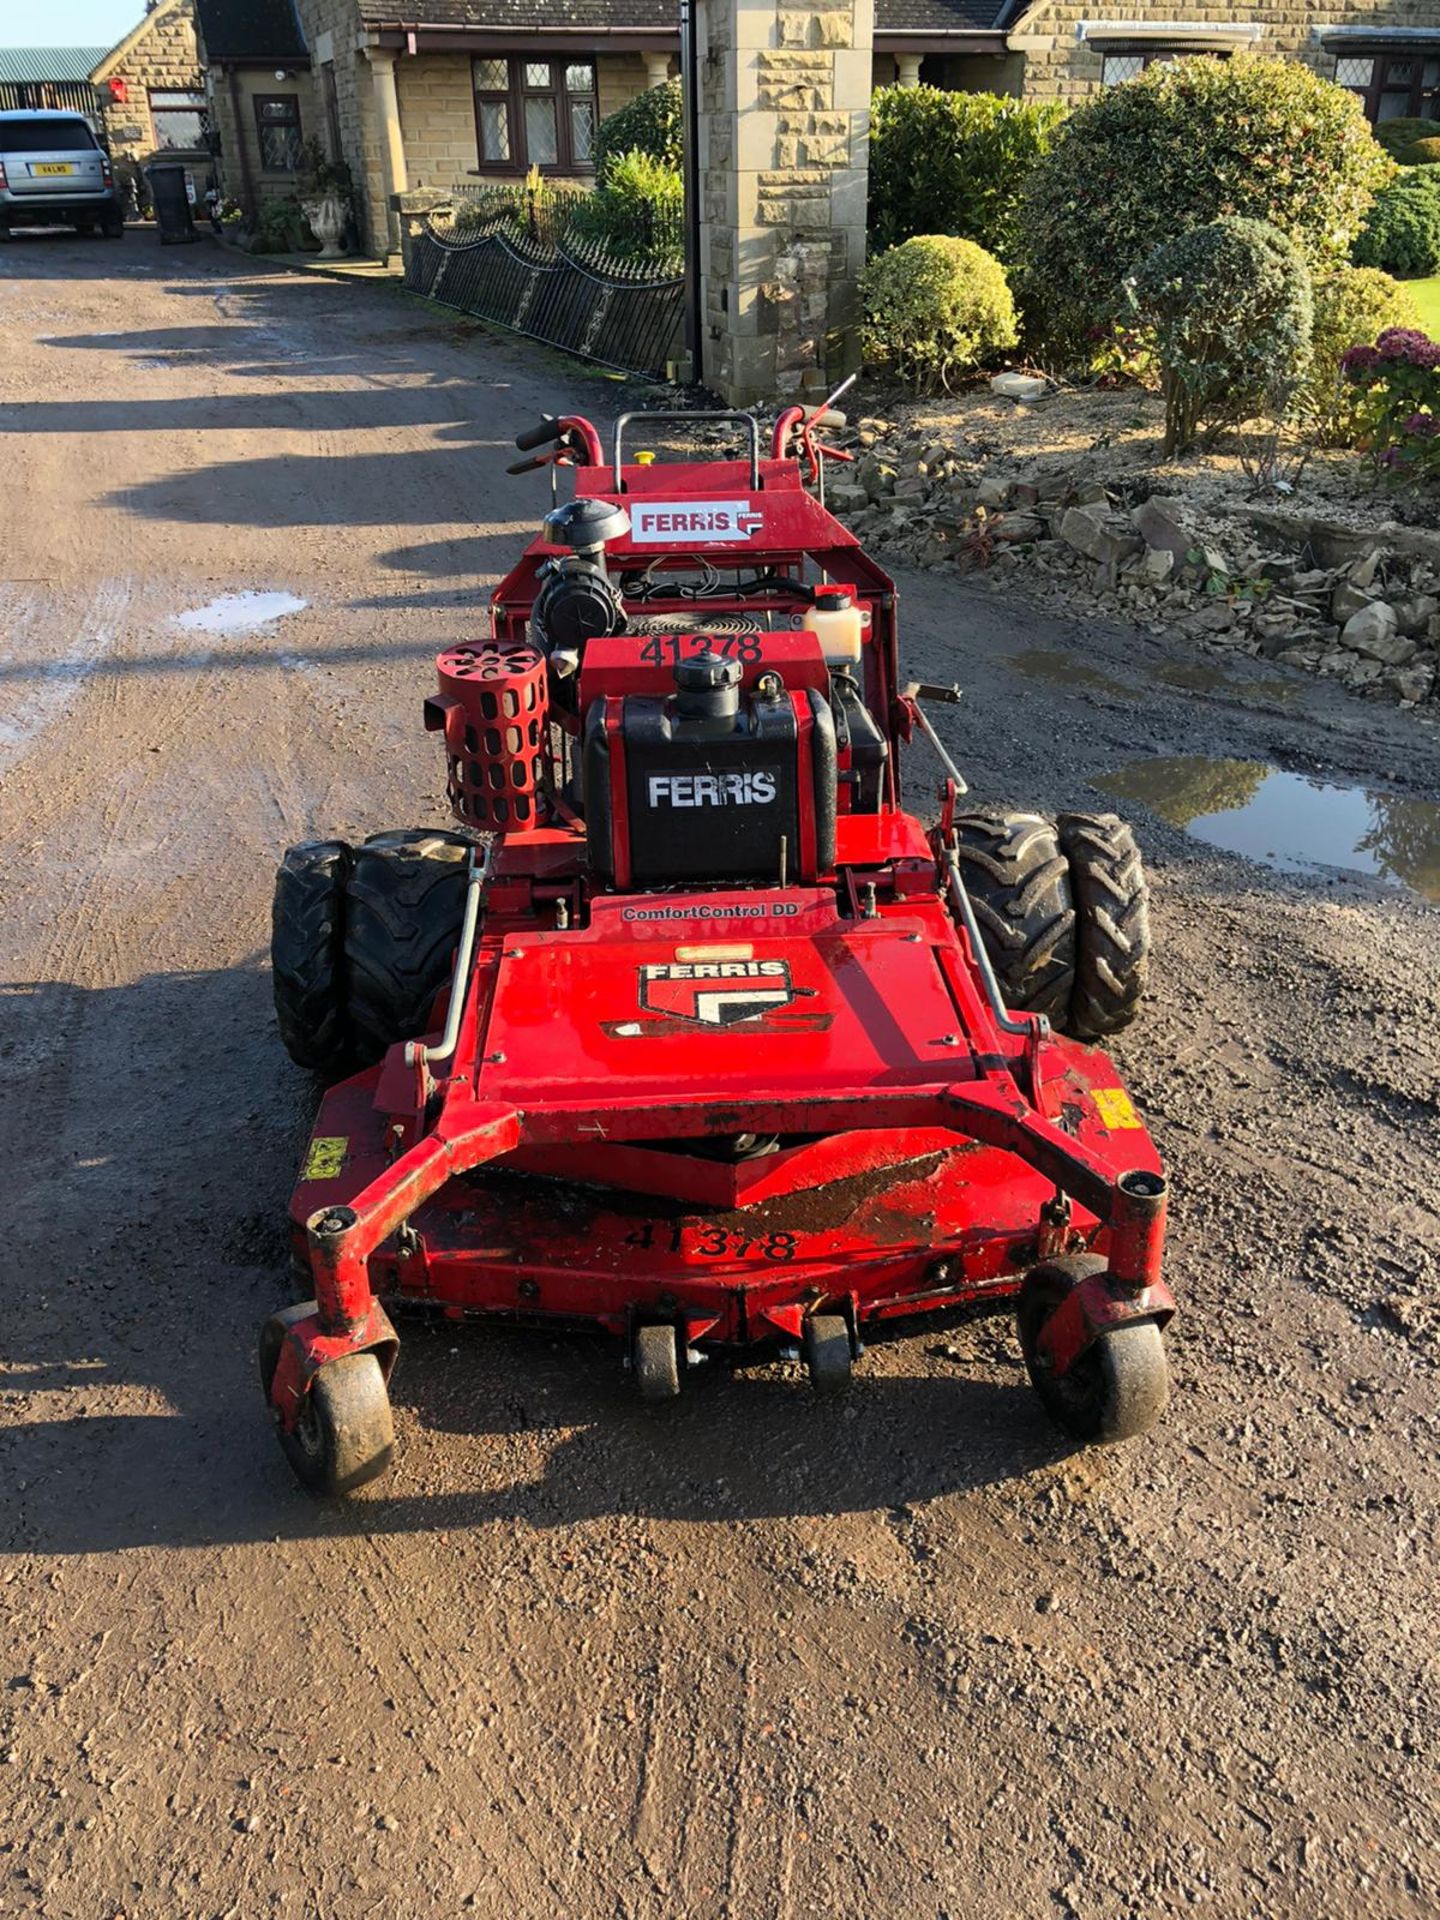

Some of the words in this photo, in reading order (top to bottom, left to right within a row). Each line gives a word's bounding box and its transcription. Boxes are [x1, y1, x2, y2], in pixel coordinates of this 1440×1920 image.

[642, 512, 730, 532] FERRIS
[649, 772, 776, 808] FERRIS
[625, 906, 765, 919] ComfortControl
[772, 904, 797, 915] DD
[646, 961, 785, 979] FERRIS
[625, 1224, 796, 1262] 41378
